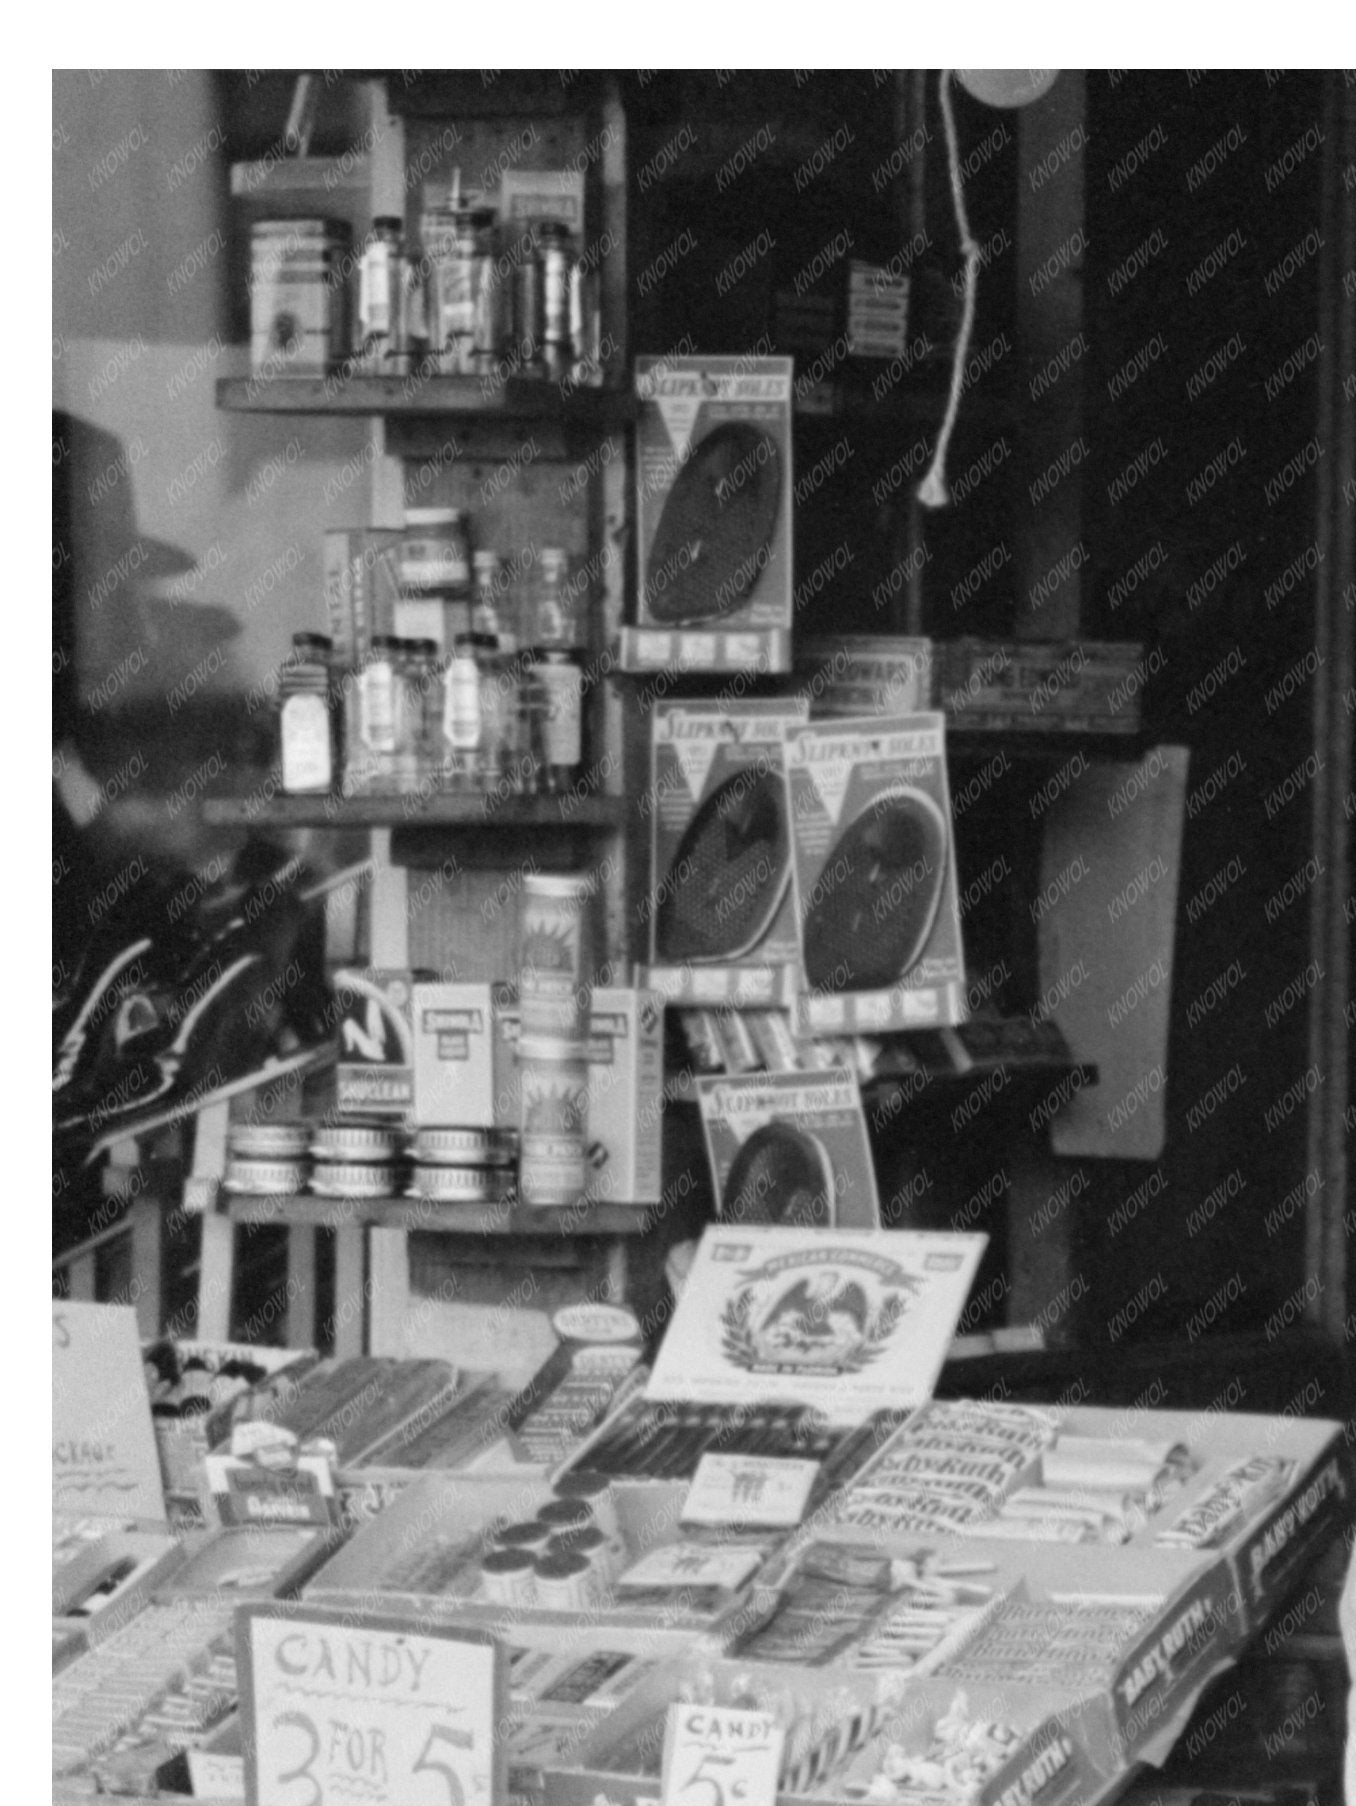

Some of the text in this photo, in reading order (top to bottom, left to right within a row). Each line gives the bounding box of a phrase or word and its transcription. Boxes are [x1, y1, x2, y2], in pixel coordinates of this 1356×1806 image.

[274, 1633, 432, 1692] CANDY
[329, 1718, 389, 1783] FOR
[686, 1713, 775, 1741] CANDY
